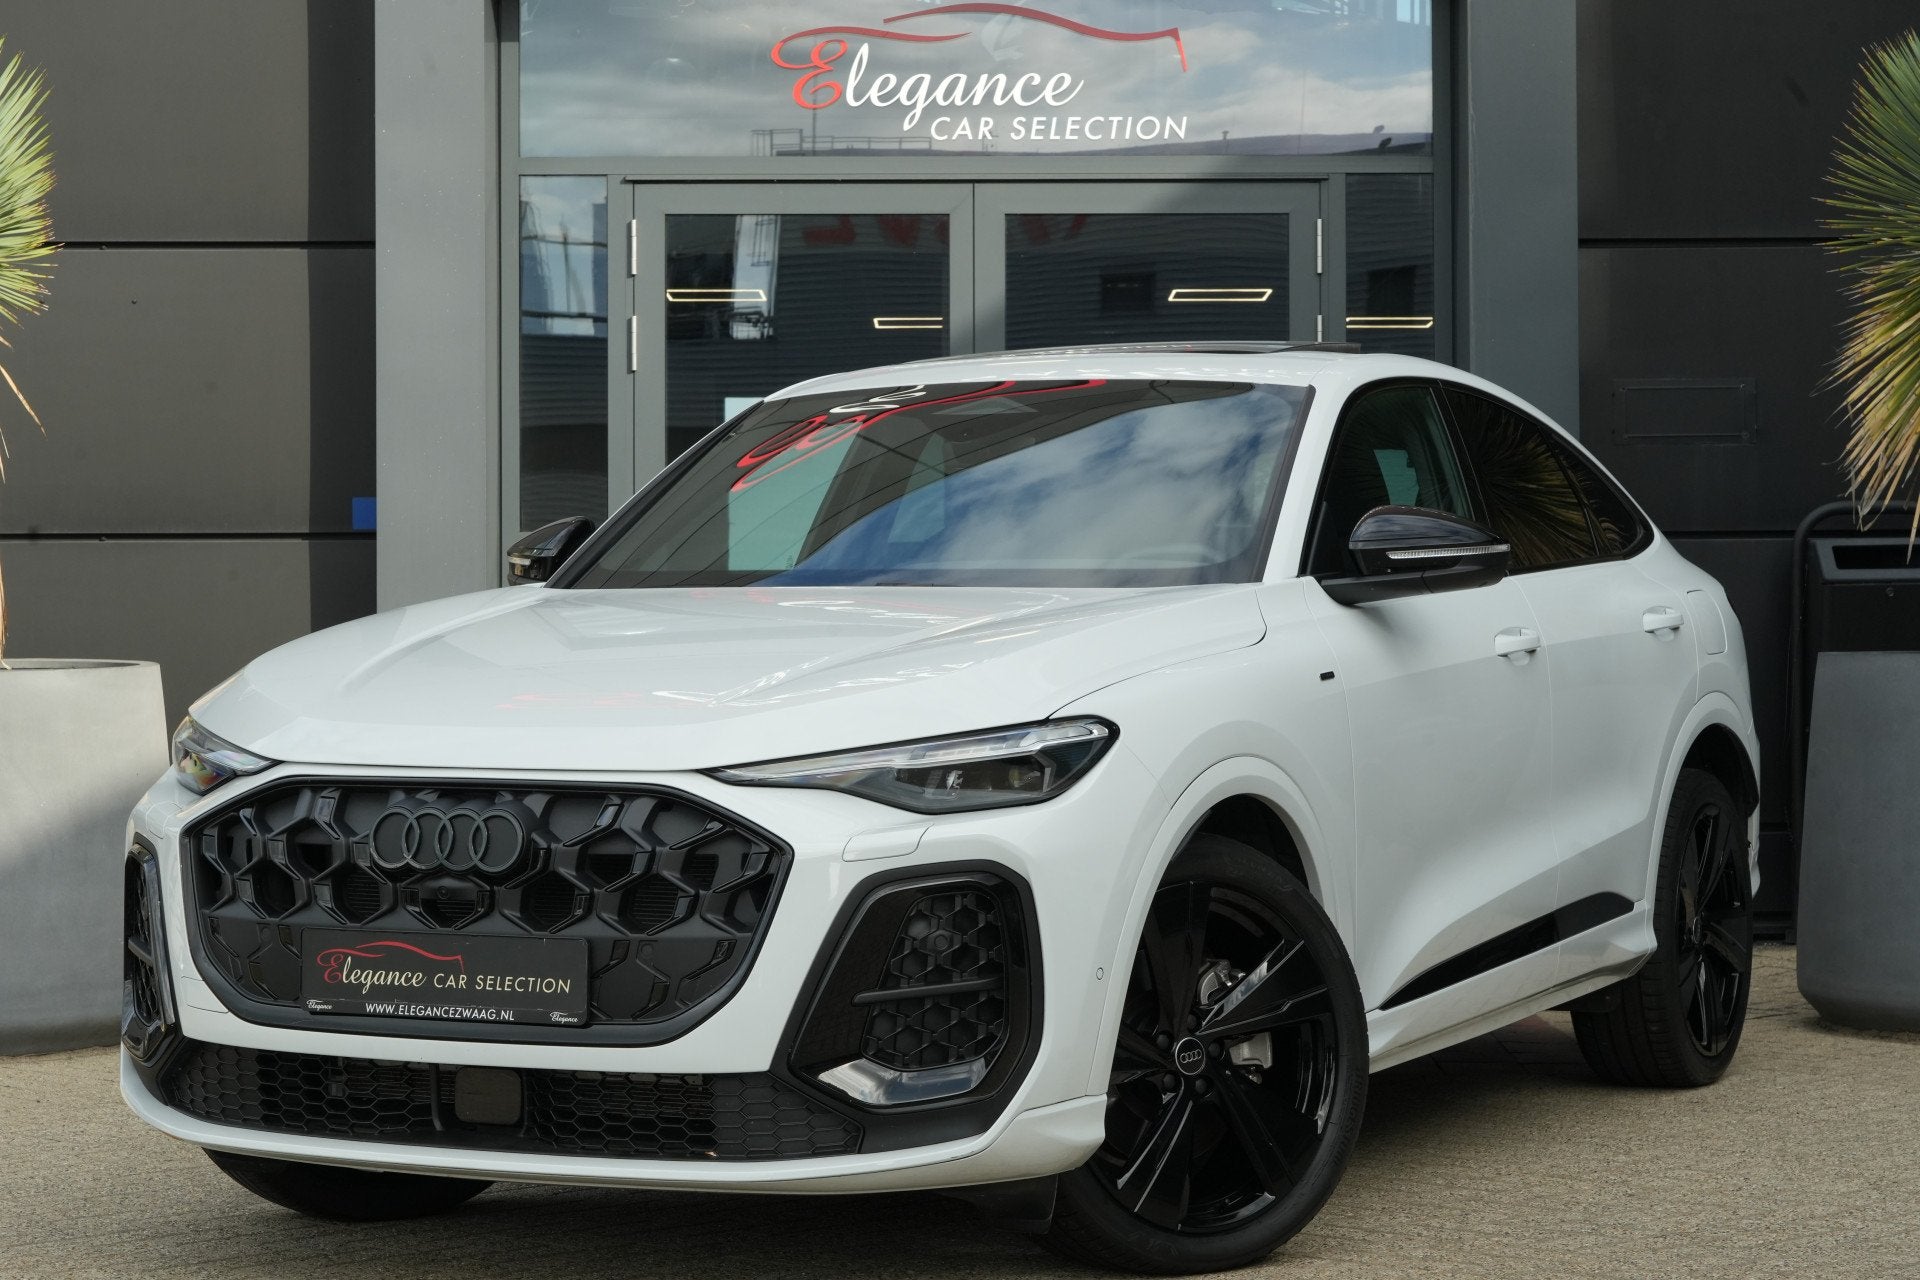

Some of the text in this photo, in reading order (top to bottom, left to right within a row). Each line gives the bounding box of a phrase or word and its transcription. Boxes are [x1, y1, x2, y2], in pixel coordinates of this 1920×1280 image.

[771, 38, 1084, 131] Elegance
[930, 115, 1189, 141] CAR SELECTION
[317, 953, 571, 995] Elegance CAR SELECTION
[365, 1002, 515, 1021] WWW.ELEGANCEZWAAG.NL
